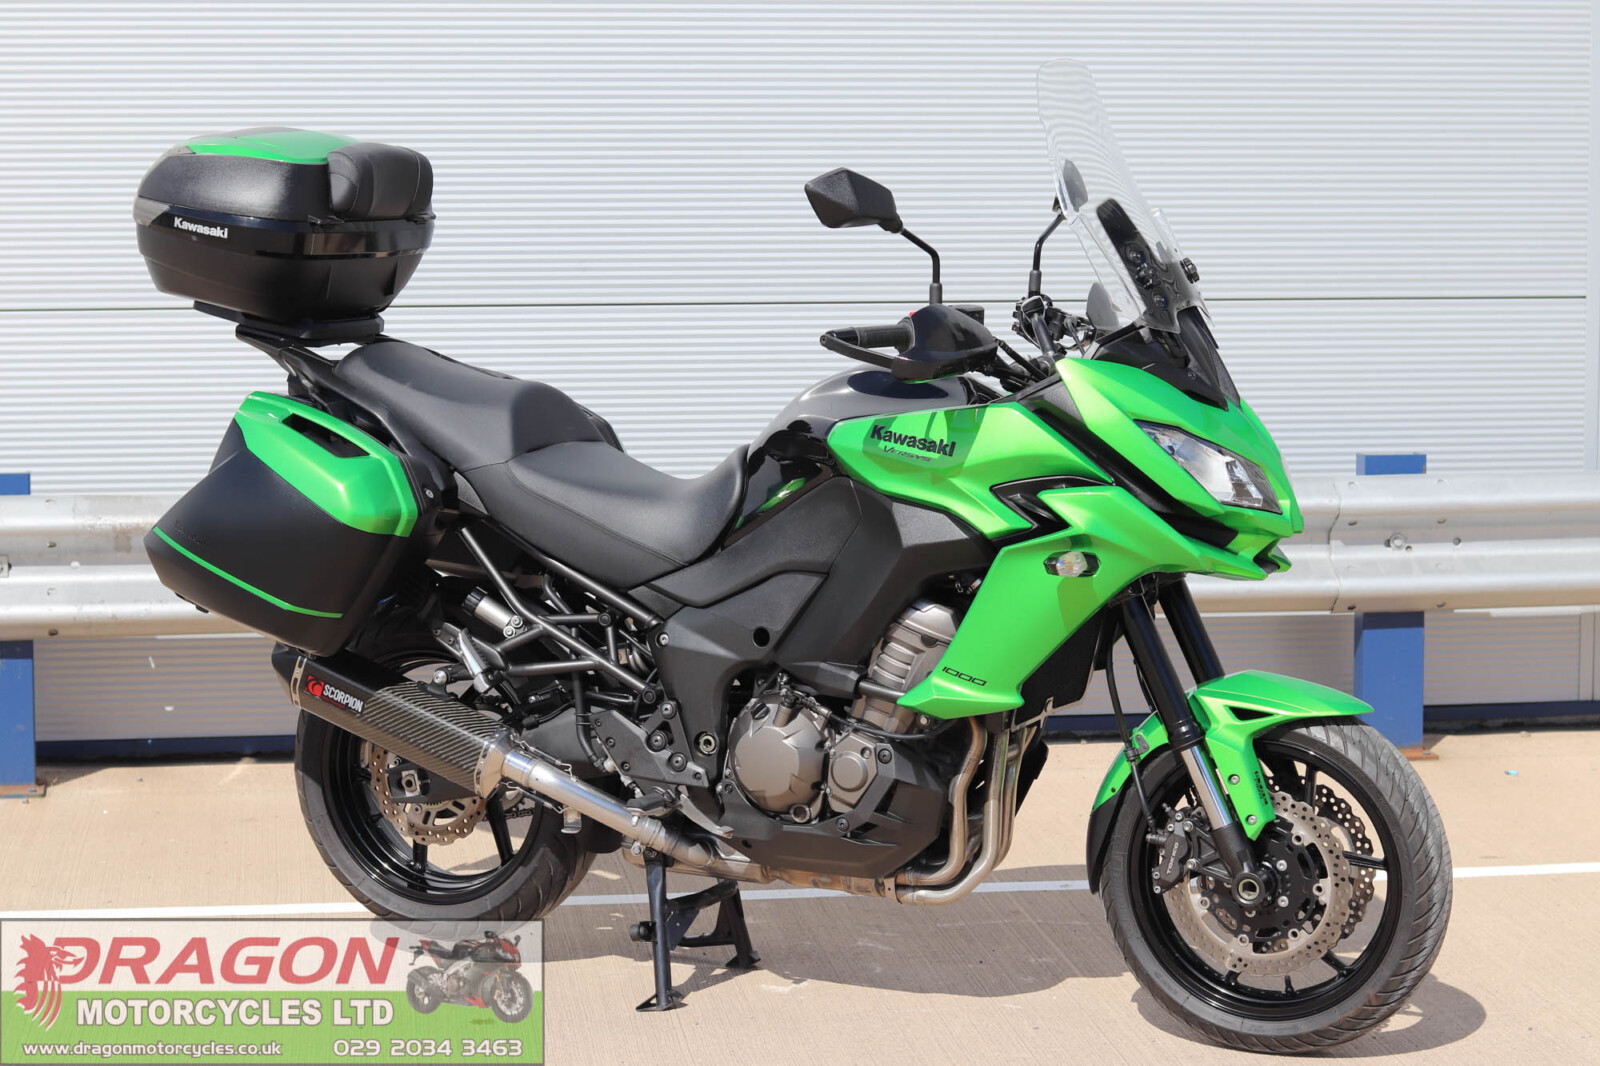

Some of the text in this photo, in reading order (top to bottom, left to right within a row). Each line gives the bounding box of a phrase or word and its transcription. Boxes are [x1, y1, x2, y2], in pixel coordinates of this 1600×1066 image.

[174, 216, 228, 239] Kawasaki
[870, 424, 956, 457] Kawasaki
[942, 666, 987, 686] 1000
[323, 684, 363, 712] SCORPION
